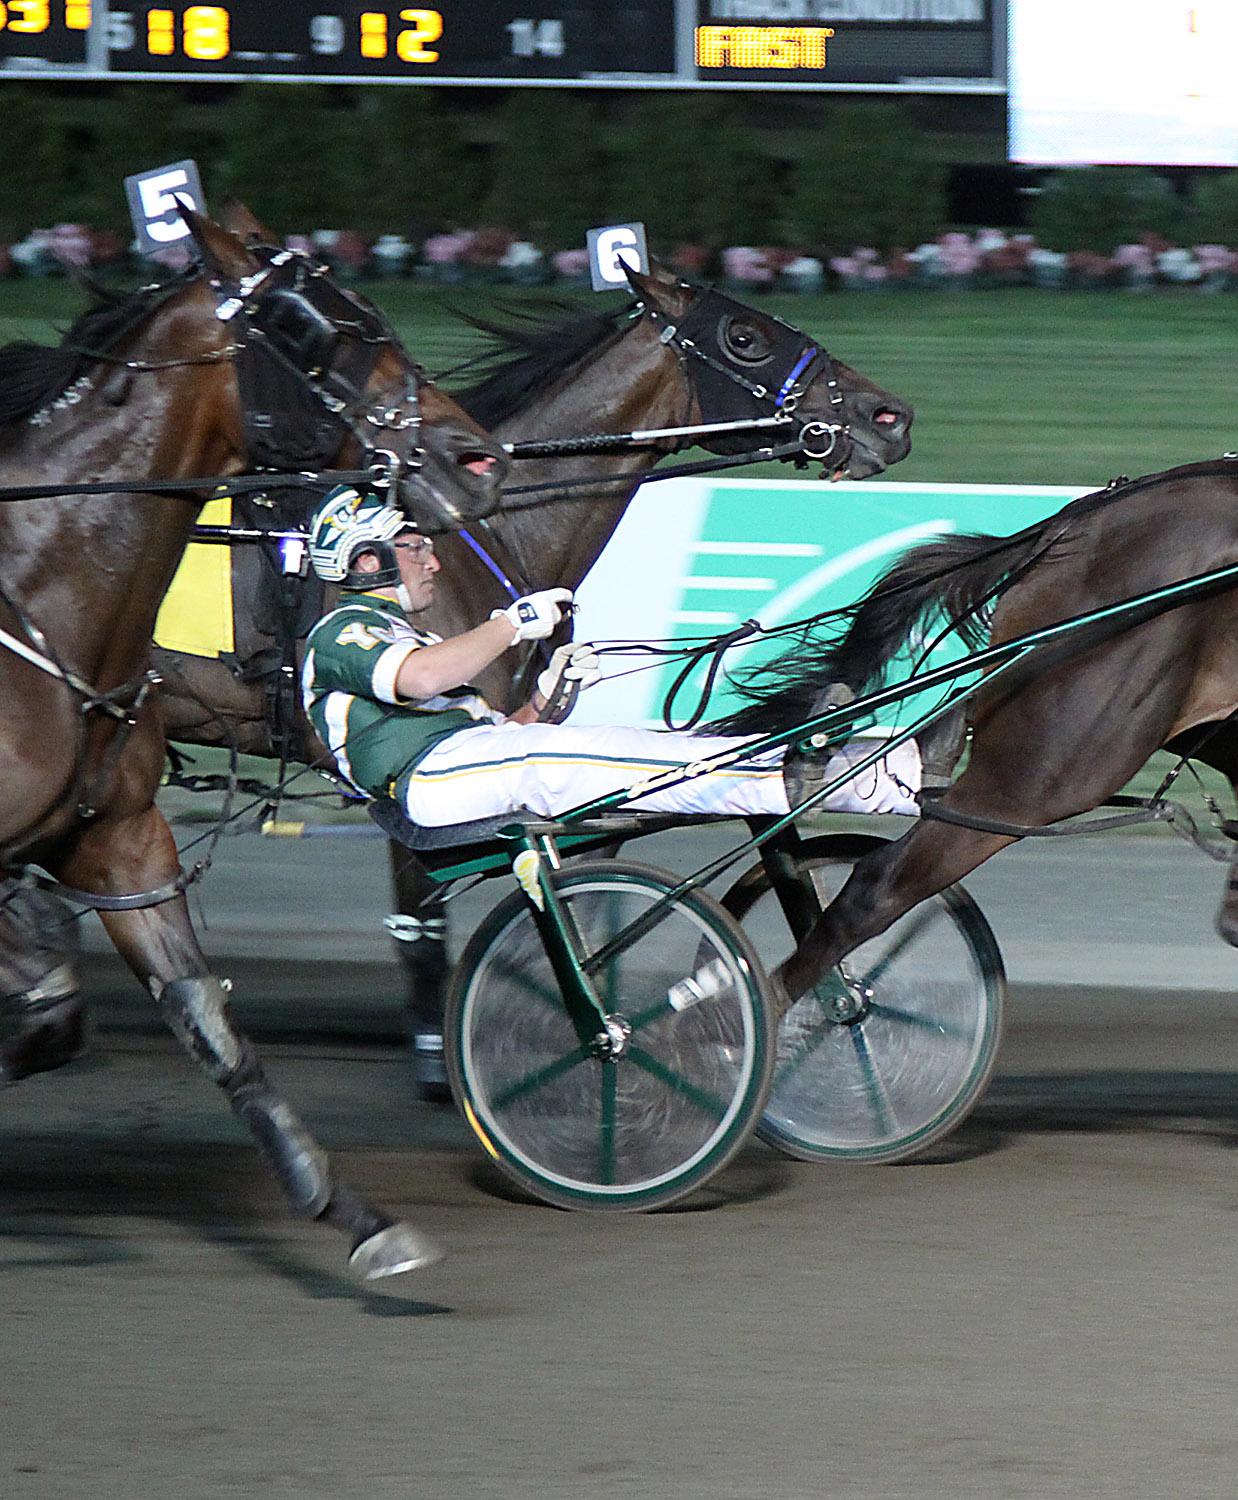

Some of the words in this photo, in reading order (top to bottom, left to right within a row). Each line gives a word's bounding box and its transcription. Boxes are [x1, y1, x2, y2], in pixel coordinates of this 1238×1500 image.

[147, 6, 230, 60] 18
[310, 15, 345, 54] 9
[360, 9, 443, 63] 12
[138, 169, 197, 242] 5
[596, 227, 641, 283] 6
